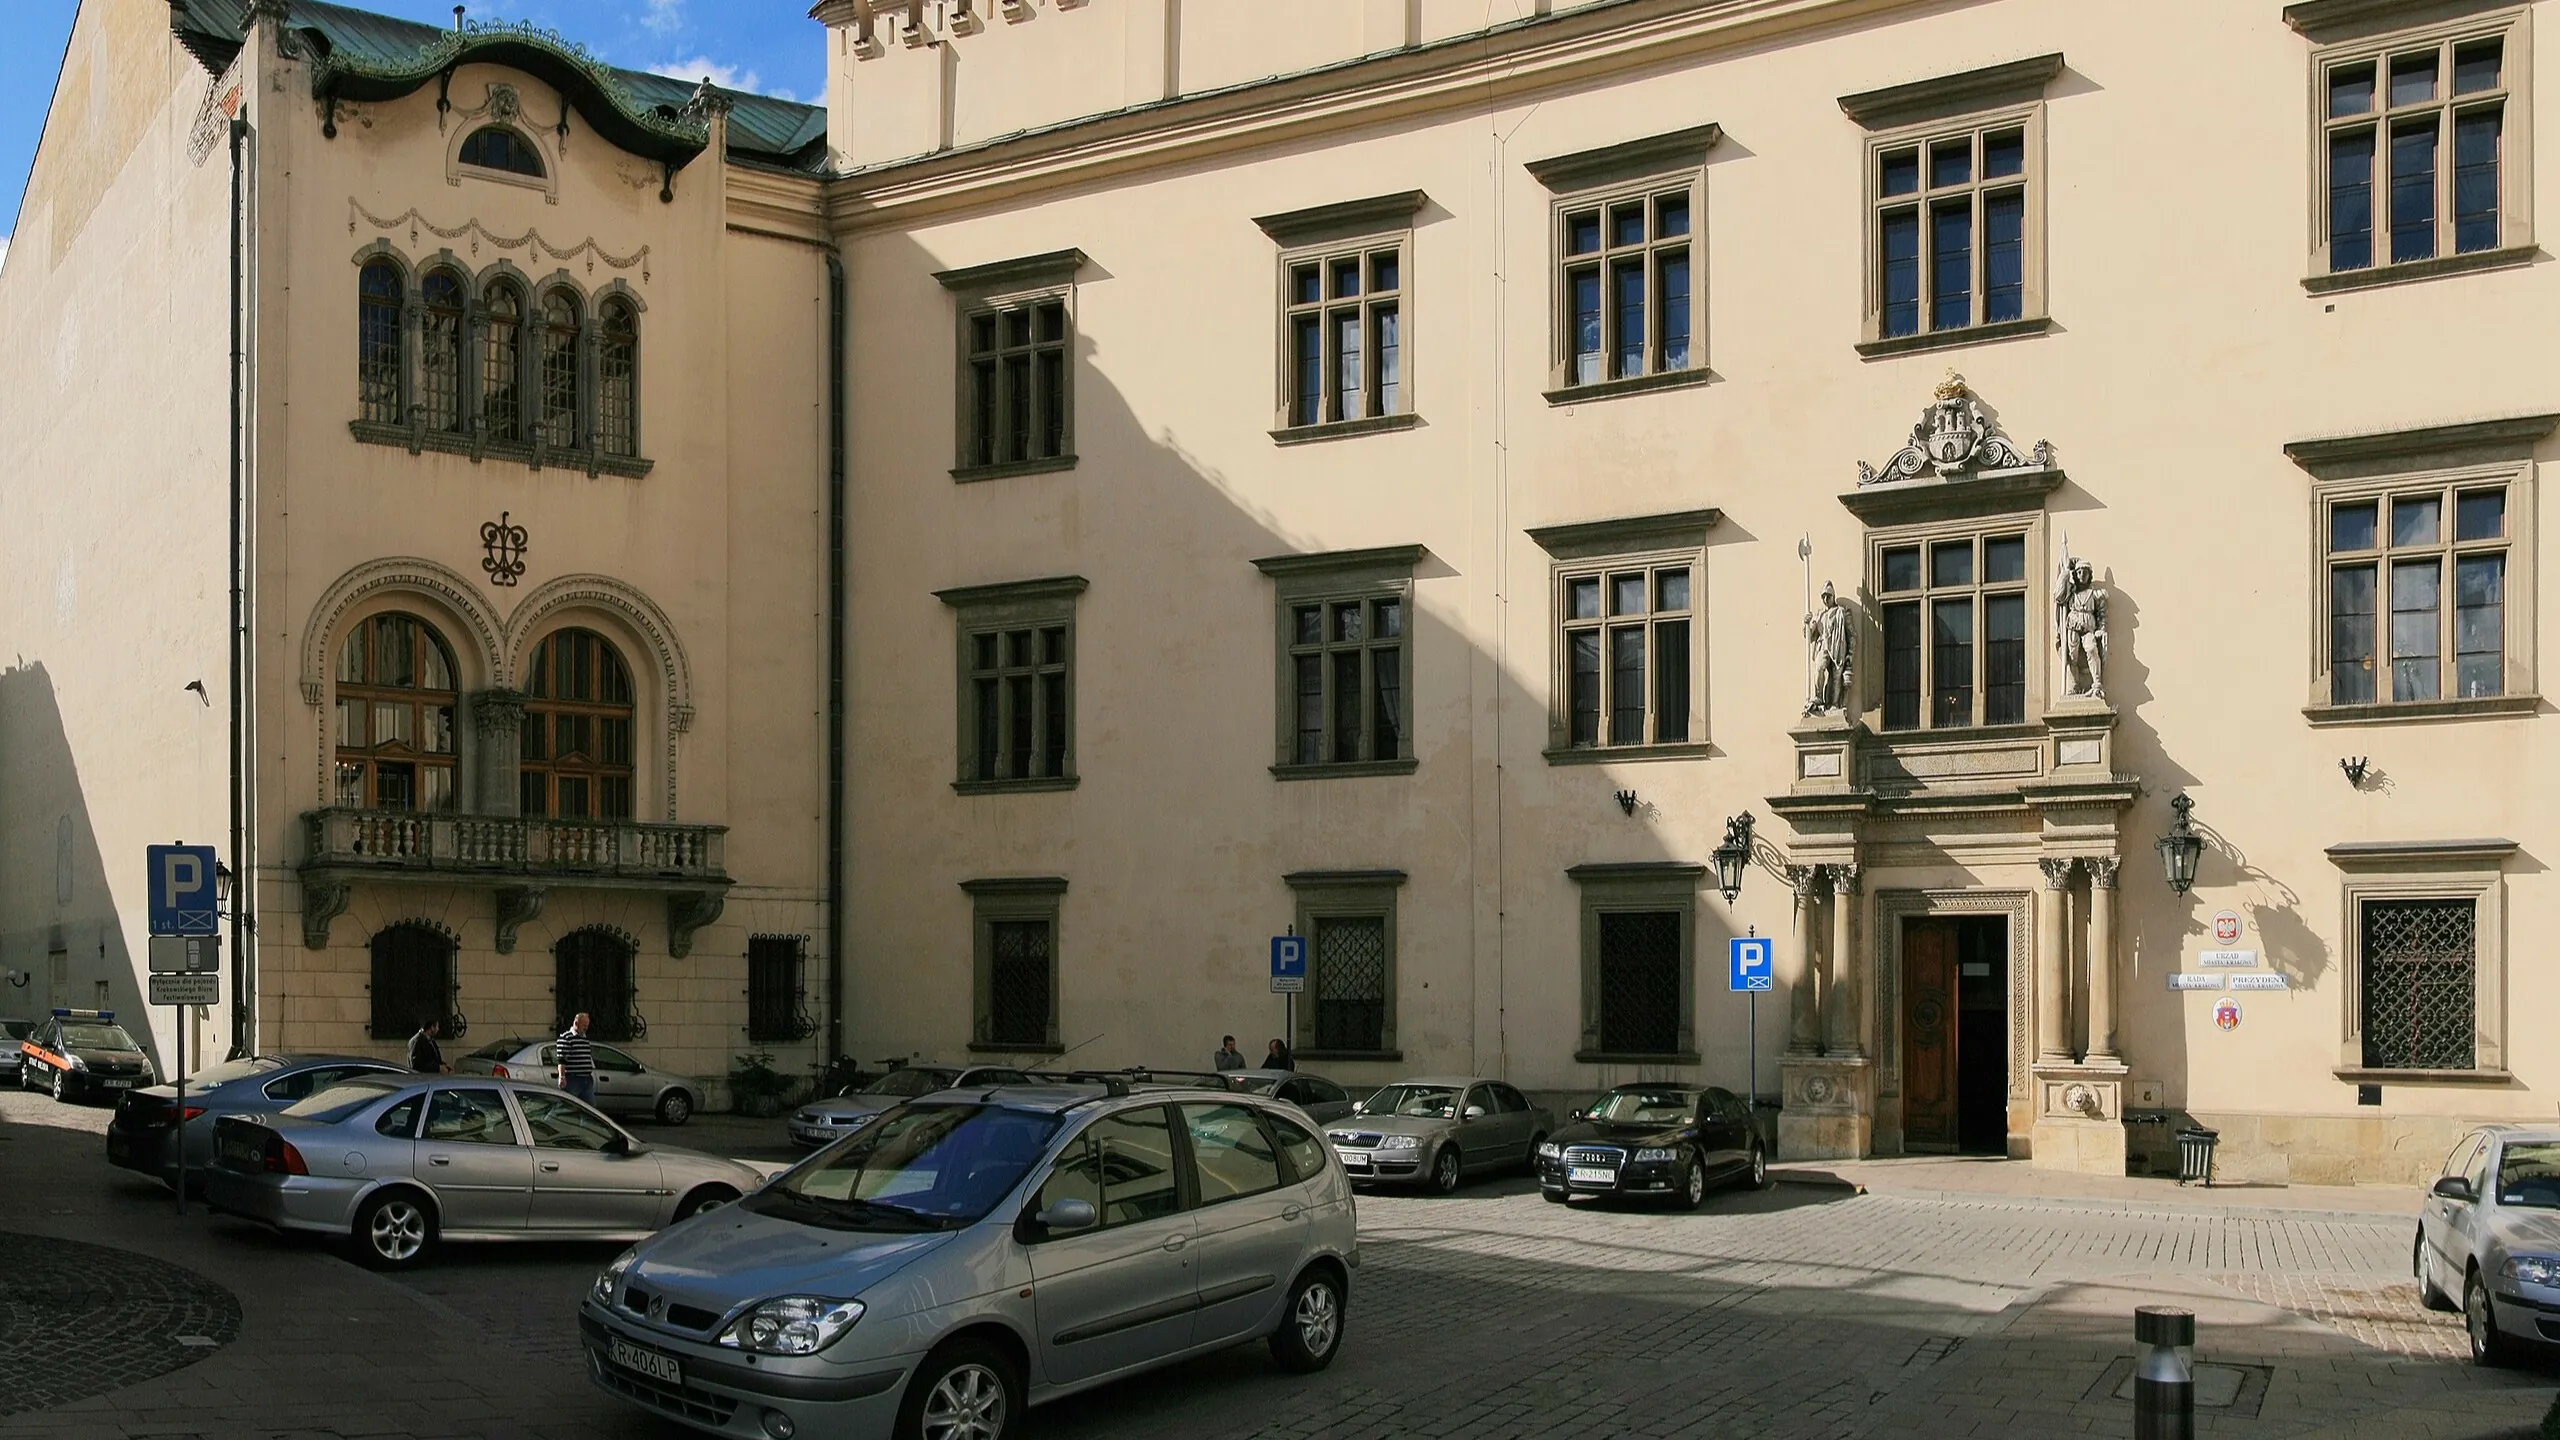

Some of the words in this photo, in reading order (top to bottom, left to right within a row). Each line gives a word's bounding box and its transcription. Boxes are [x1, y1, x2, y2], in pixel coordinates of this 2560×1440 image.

[165, 853, 202, 908] P
[153, 919, 158, 930] 1
[162, 919, 174, 930] st.
[1280, 940, 1299, 970] P
[1740, 943, 1763, 976] P
[609, 1340, 628, 1365] KR
[632, 1348, 677, 1380] 406LP
